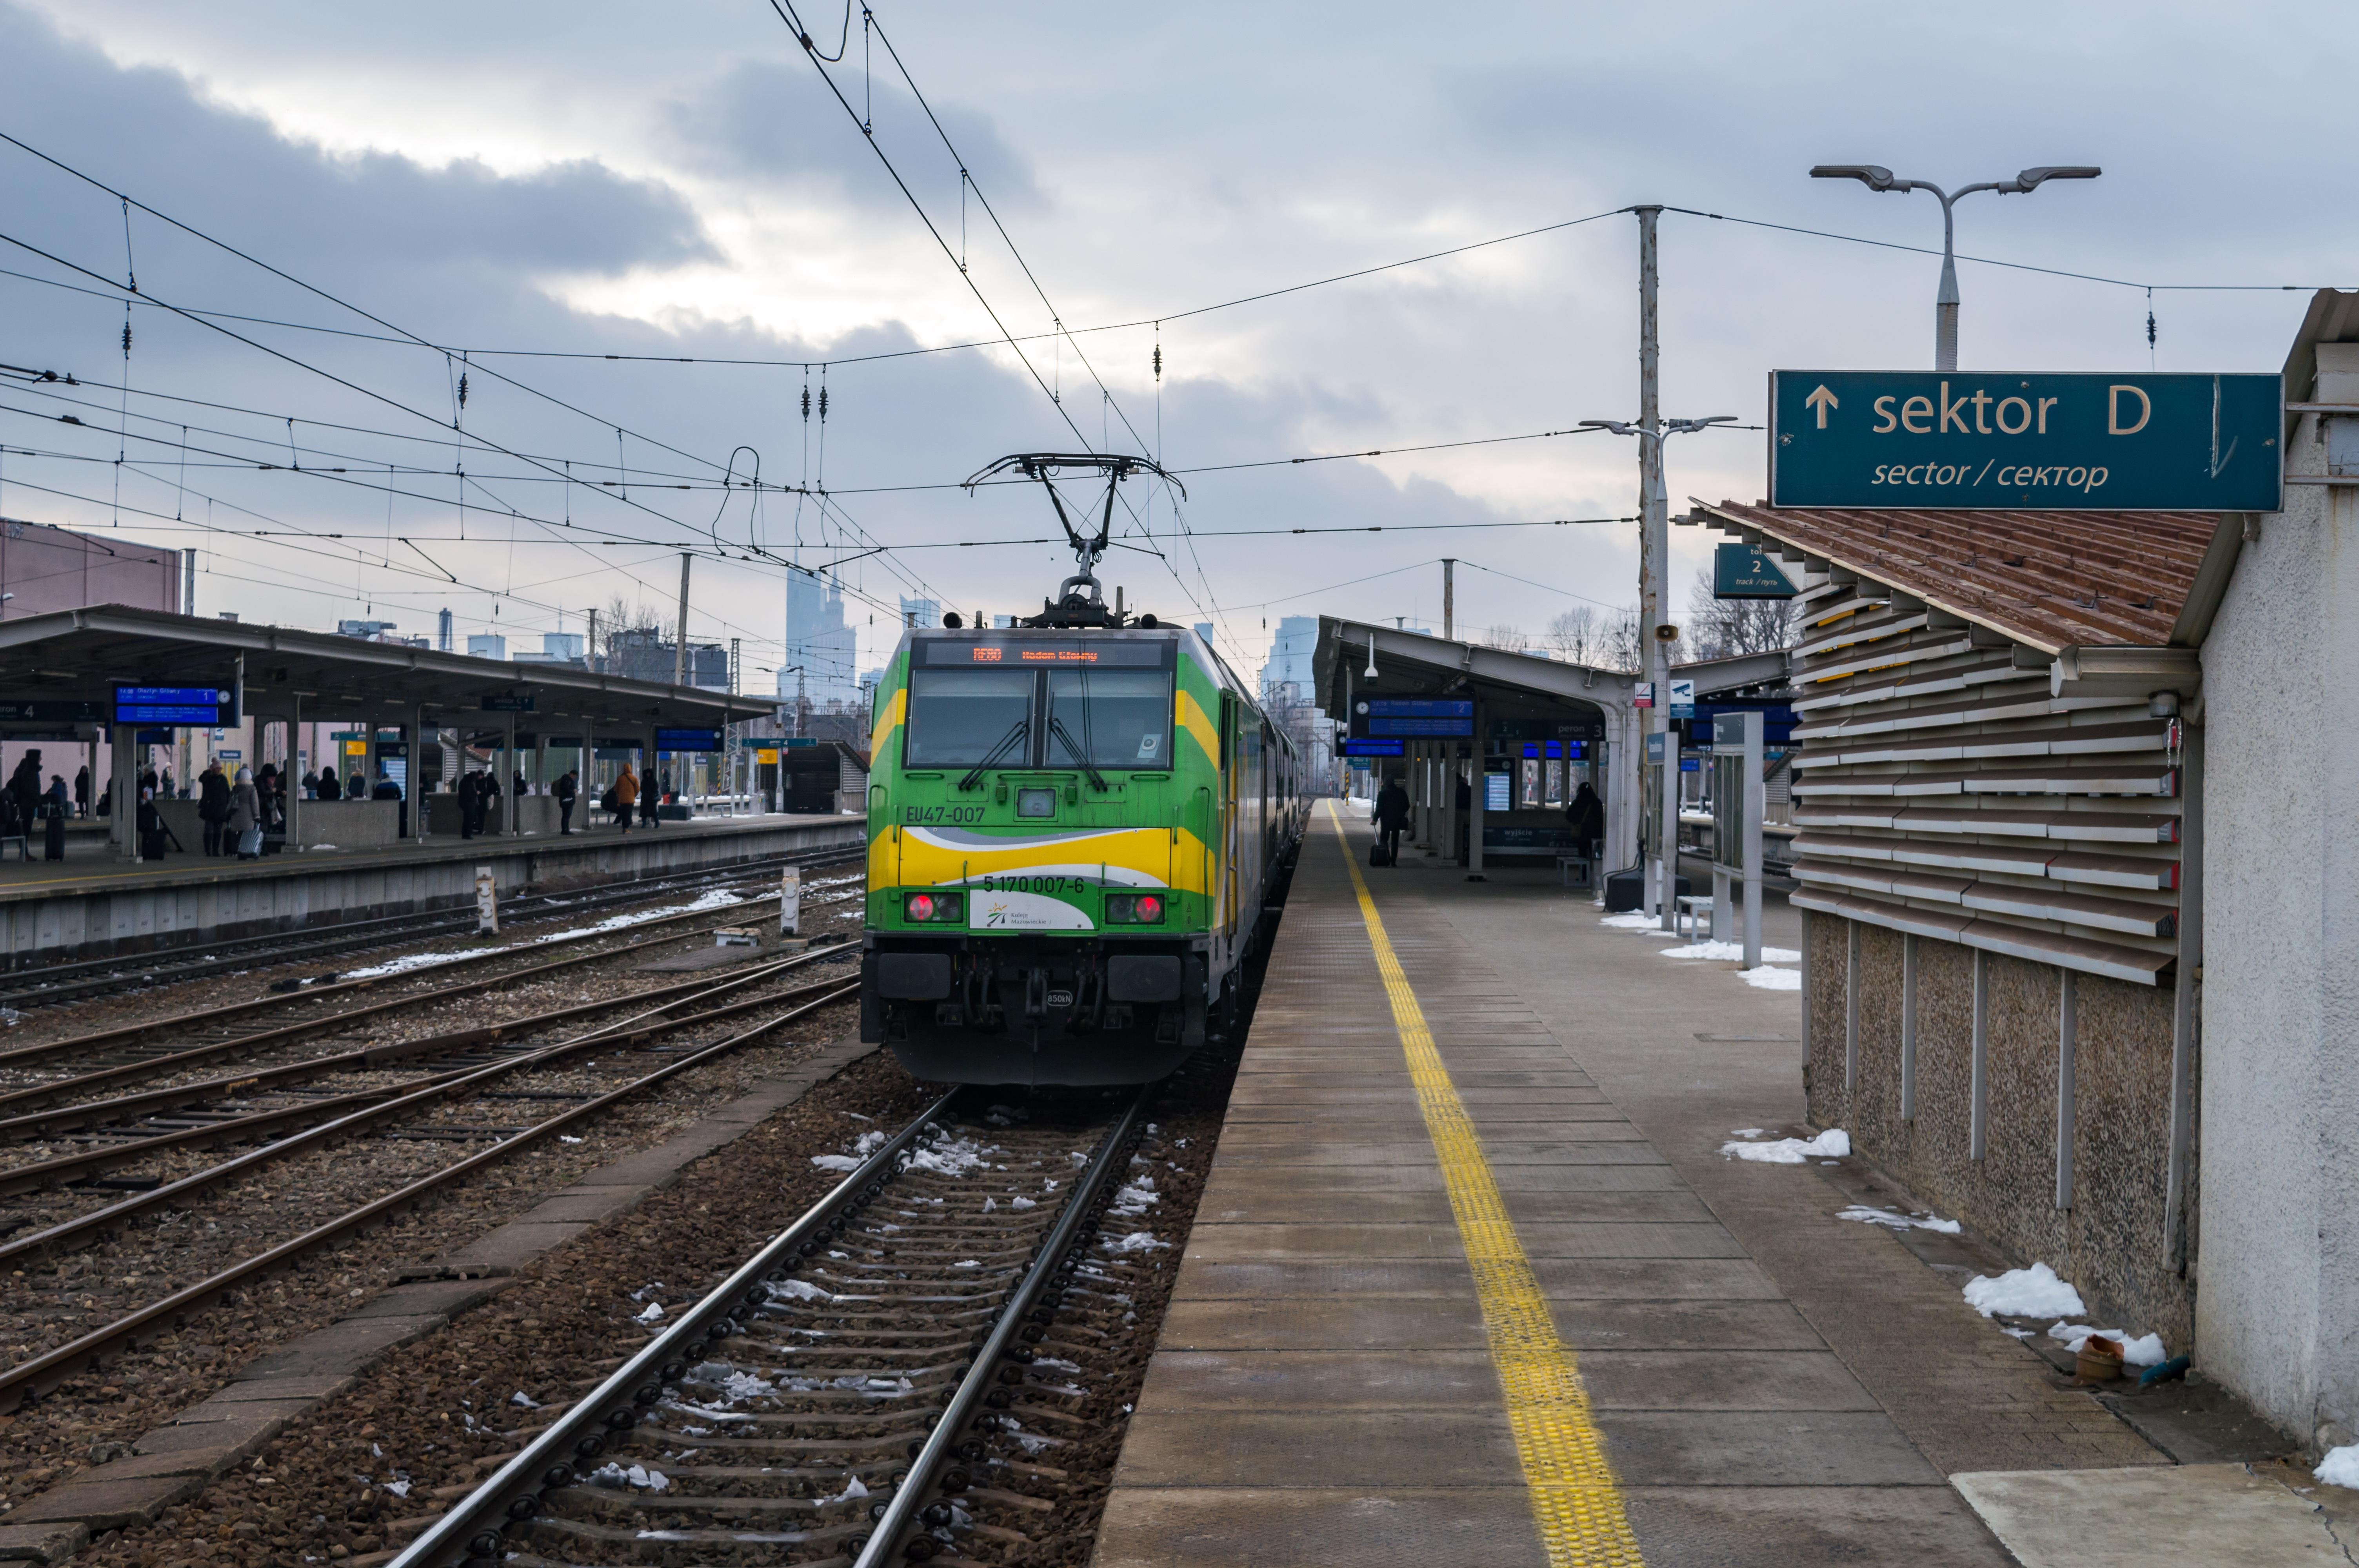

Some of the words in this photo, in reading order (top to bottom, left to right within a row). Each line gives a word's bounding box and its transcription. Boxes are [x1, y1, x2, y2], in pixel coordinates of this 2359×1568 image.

[1873, 381, 2057, 435] sektor
[2110, 386, 2151, 435] D
[1872, 462, 1971, 485] sector
[1997, 465, 2108, 494] сектор
[1752, 561, 1761, 573] 2
[204, 691, 208, 701] 1
[25, 705, 35, 718] 4
[1459, 704, 1465, 713] 2
[1558, 726, 1585, 734] peron
[1594, 724, 1603, 737] 3
[907, 806, 985, 822] EU47-007
[984, 876, 993, 892] 5
[1000, 876, 1029, 892] 170
[1034, 876, 1084, 893] 007-6
